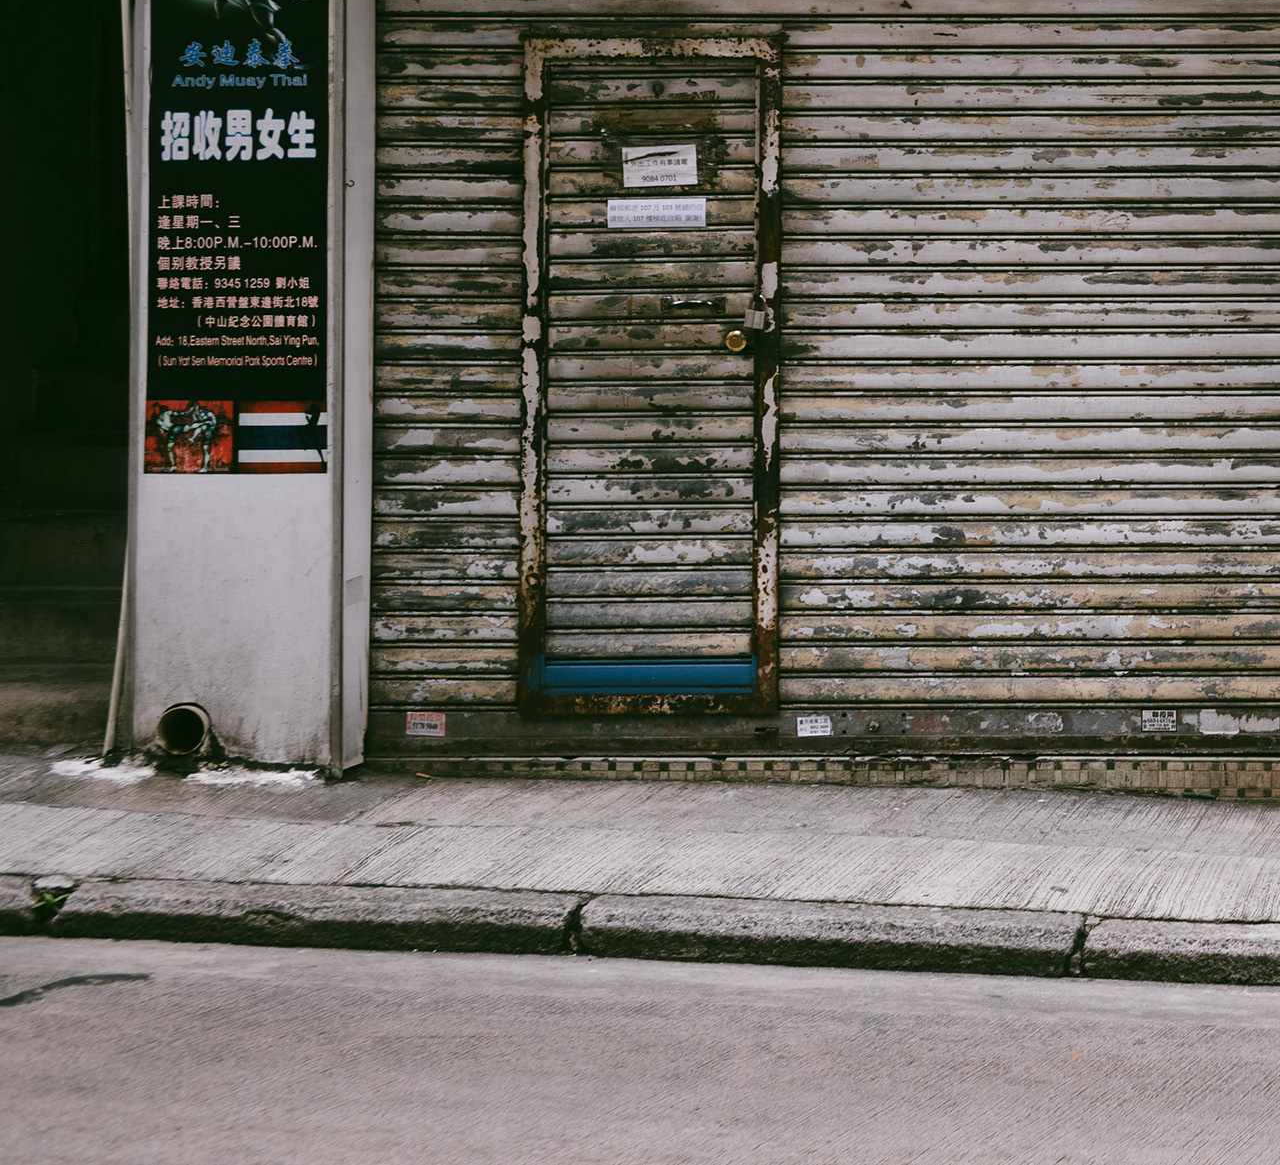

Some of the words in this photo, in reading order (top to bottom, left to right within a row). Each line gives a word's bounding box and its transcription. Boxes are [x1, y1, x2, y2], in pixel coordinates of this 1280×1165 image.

[180, 38, 299, 69] 安迪泰拳
[172, 74, 216, 89] Andy
[219, 74, 266, 89] Muay
[269, 73, 308, 86] Thai
[161, 107, 317, 161] 招收男女生
[641, 175, 659, 183] 9084
[660, 174, 677, 182] 0701
[157, 194, 220, 209] 上課時間：
[157, 215, 242, 230] 逢星期一、三
[214, 277, 241, 289] 9345
[244, 277, 271, 289] 1259
[221, 336, 244, 346] Street
[284, 336, 300, 348] Ying
[302, 336, 320, 347] Pun,
[178, 356, 190, 366] Yat
[191, 356, 206, 366] Sen
[207, 356, 244, 366] Memorial
[245, 356, 260, 366] Park
[262, 356, 285, 368] Sports
